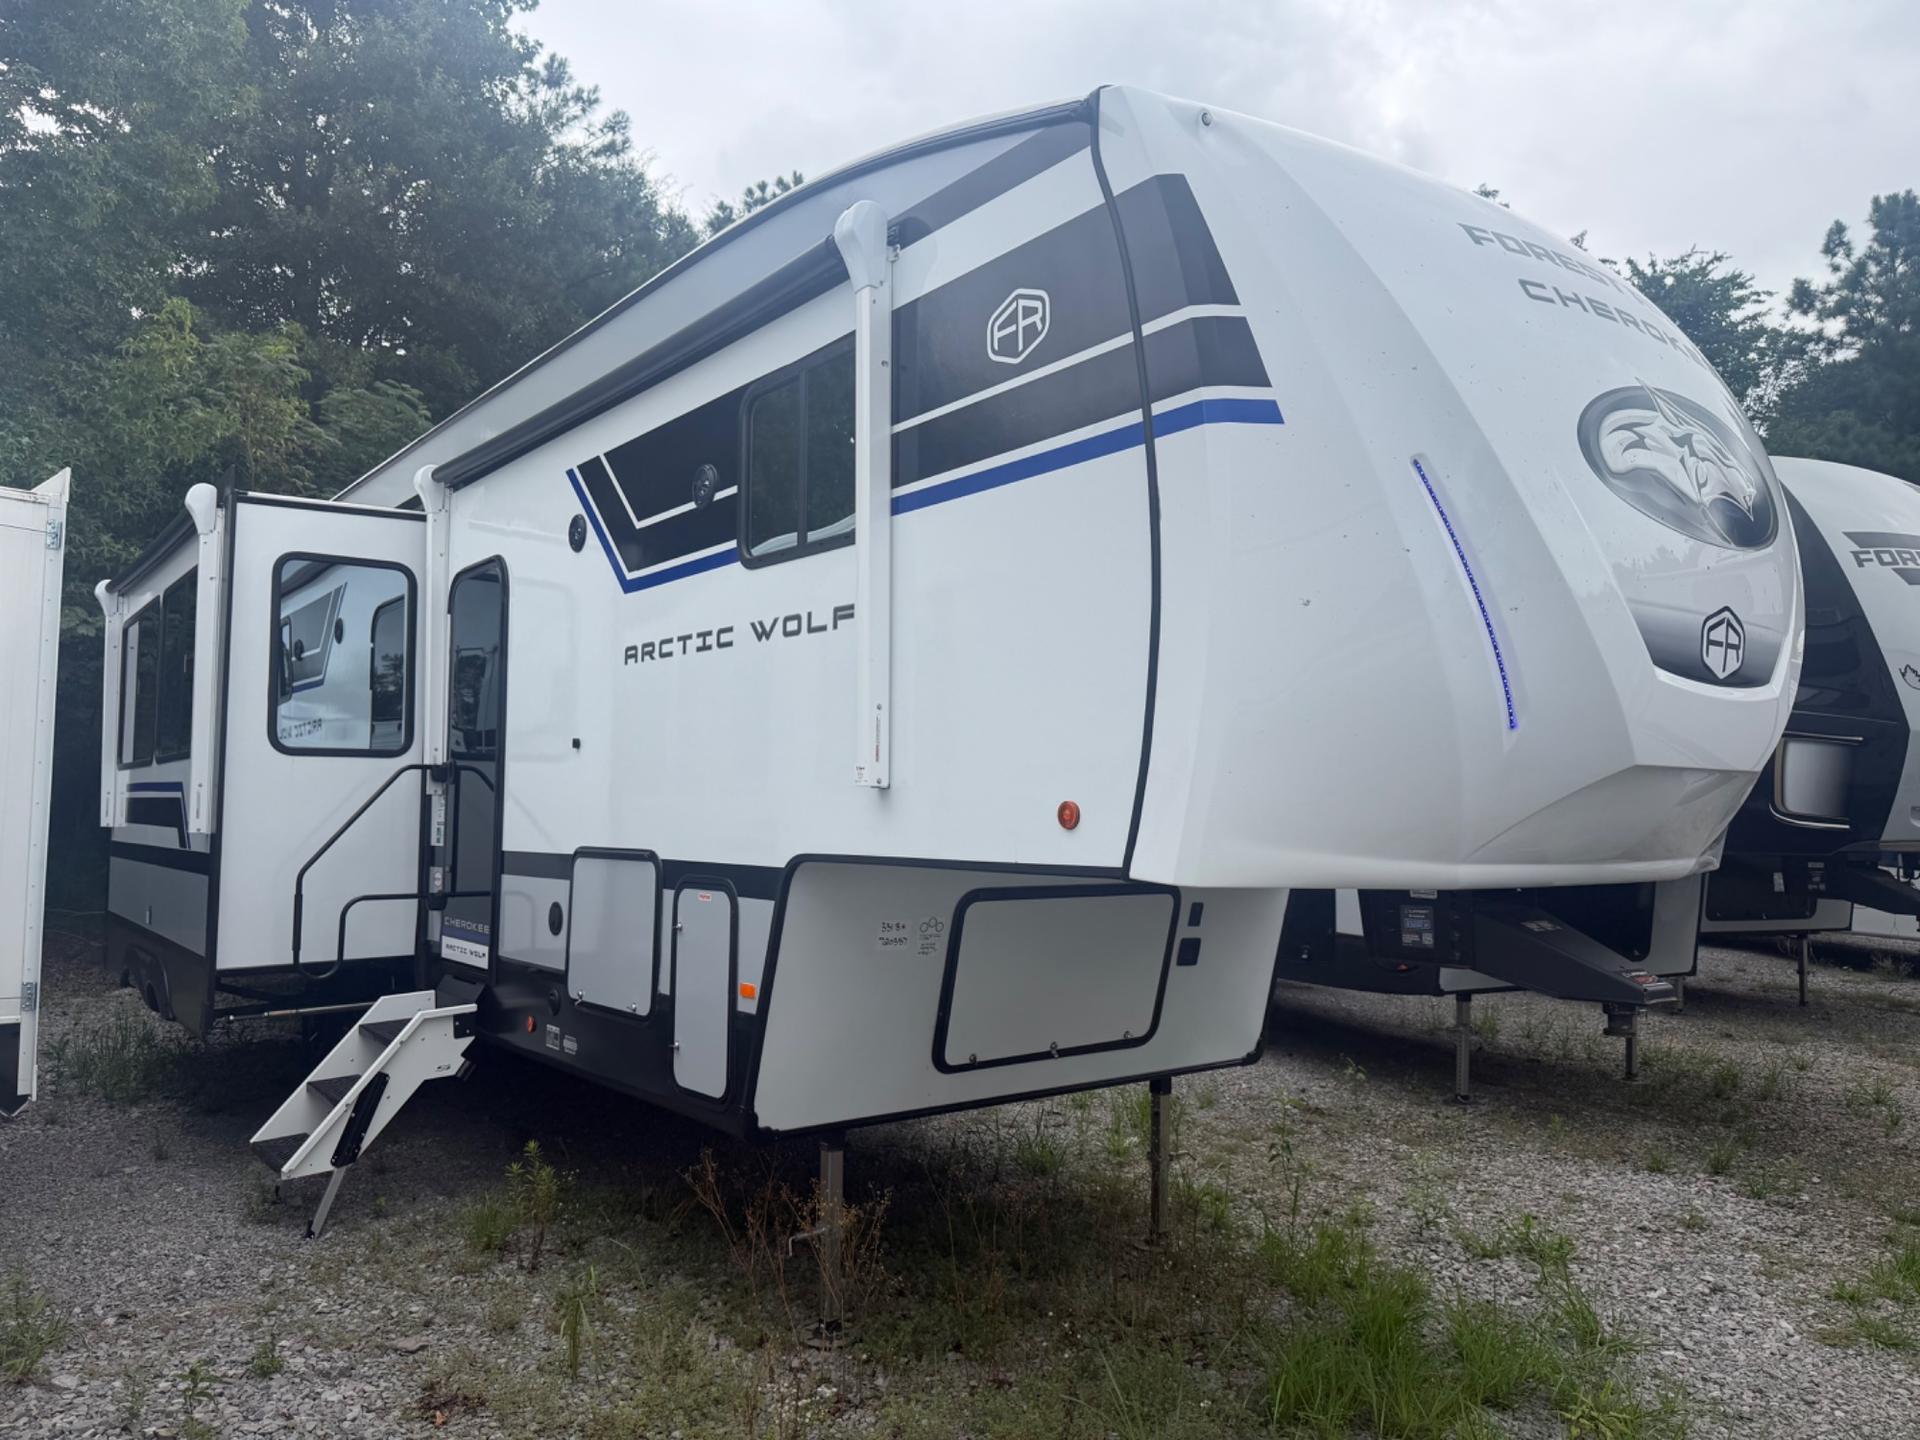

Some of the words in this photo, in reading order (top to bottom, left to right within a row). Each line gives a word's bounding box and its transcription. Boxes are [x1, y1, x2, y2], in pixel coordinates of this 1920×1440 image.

[1518, 278, 1720, 379] CHEROK
[1849, 549, 1920, 568] FOR
[624, 625, 734, 666] ARCTIC
[749, 603, 855, 643] WOLF
[443, 916, 490, 934] CHEROKEE
